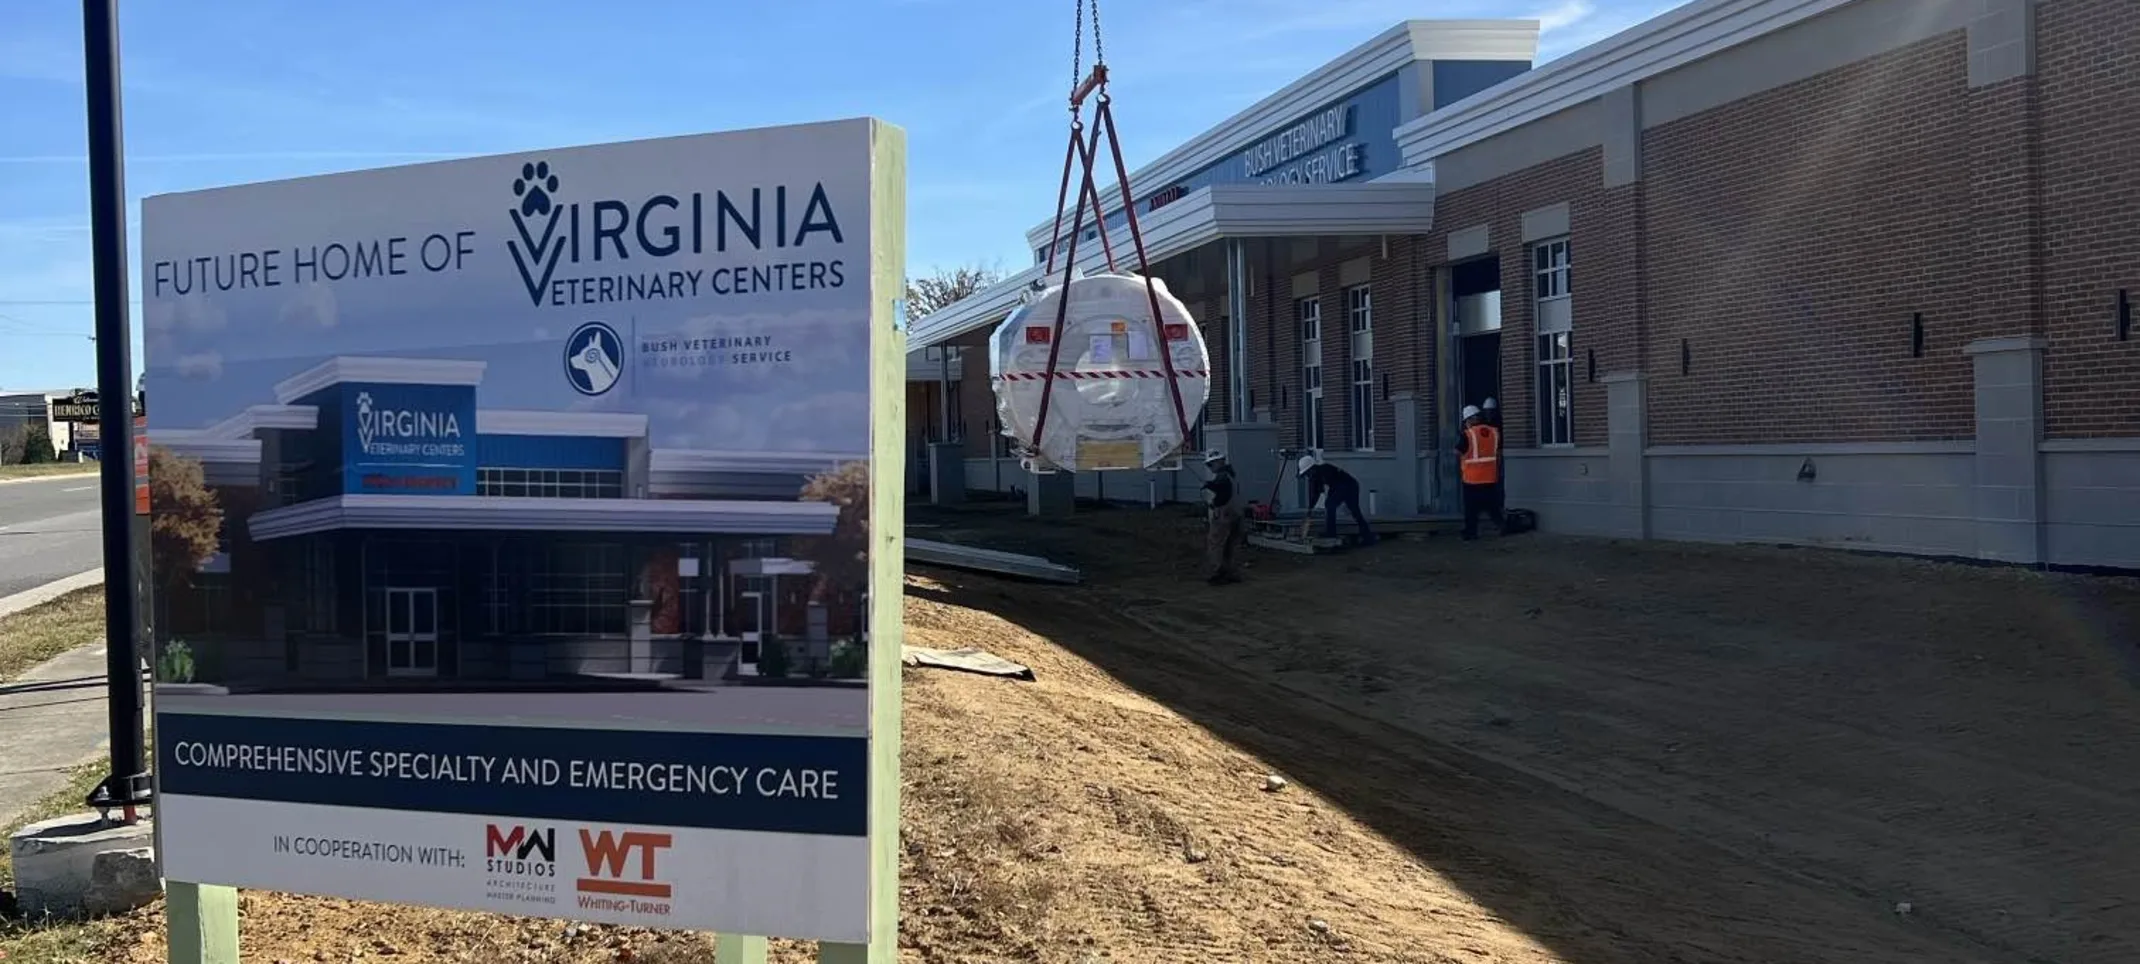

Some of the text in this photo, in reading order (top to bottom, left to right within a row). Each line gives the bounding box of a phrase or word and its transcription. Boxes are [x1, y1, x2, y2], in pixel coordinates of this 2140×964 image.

[1244, 138, 1273, 178] BUSH
[1273, 102, 1348, 162] VETERINARY
[1305, 142, 1360, 185] SERVICE
[508, 180, 844, 267] VIRGINIA
[154, 231, 476, 297] FUTURE HOME OF
[506, 235, 845, 309] VETERINARY CENTERS
[642, 335, 771, 353] BUSH VETERINARY
[731, 350, 792, 364] SERVICE
[357, 410, 461, 438] VIRGINIA
[174, 741, 839, 800] COMPREHENSIVE SPECIALTY AND EMERGENCY CARE
[273, 835, 466, 868] IN COOPERATION WITH:
[487, 859, 556, 878] STUDIOS
[578, 828, 672, 880] WT
